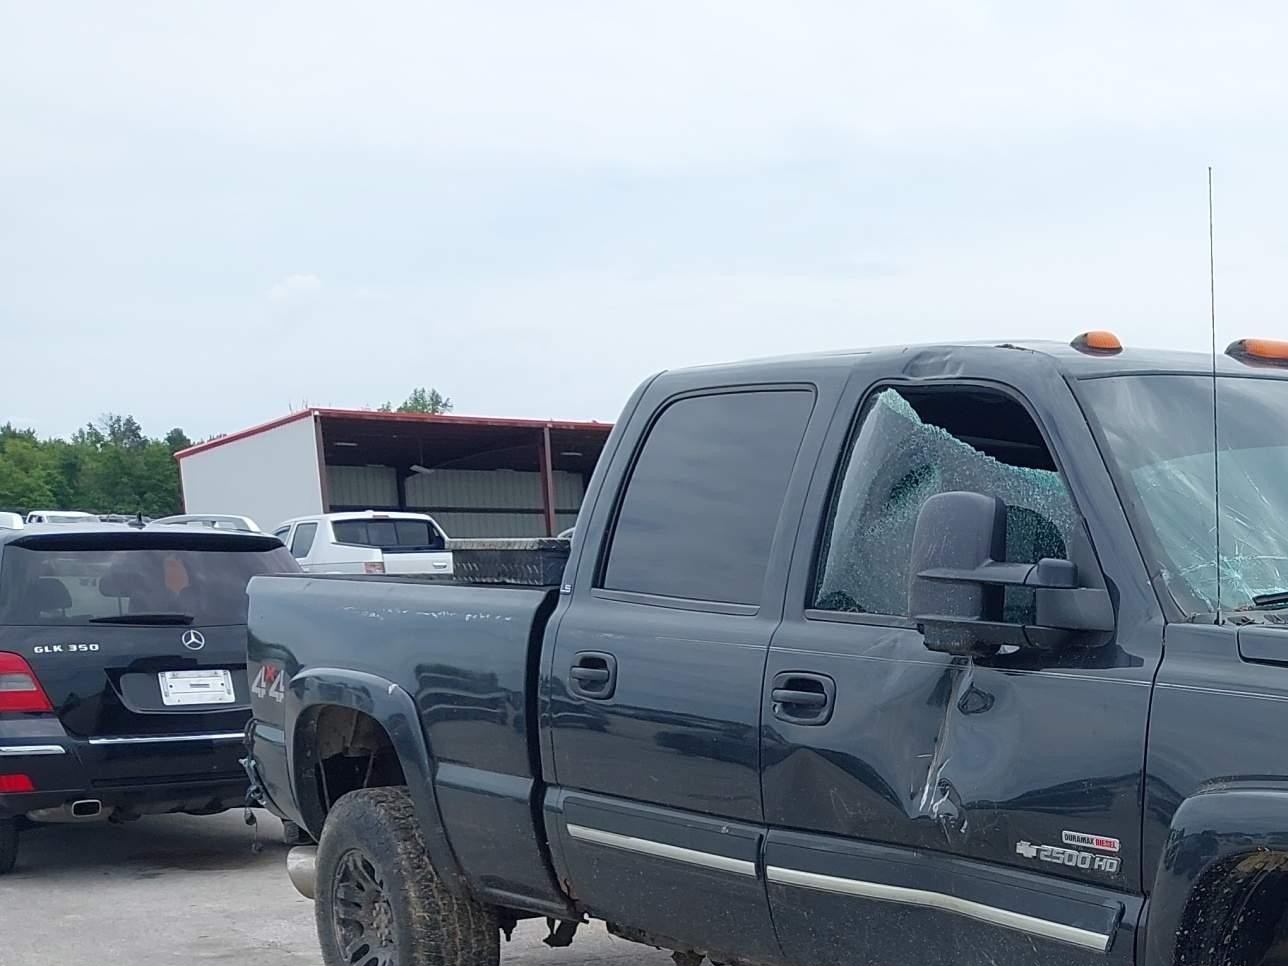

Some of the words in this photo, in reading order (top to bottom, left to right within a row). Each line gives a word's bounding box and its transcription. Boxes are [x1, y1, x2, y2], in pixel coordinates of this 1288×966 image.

[34, 644, 63, 654] GLK
[67, 643, 100, 652] 350
[1064, 833, 1094, 845] DURAMAX
[1095, 838, 1118, 849] DIESEL
